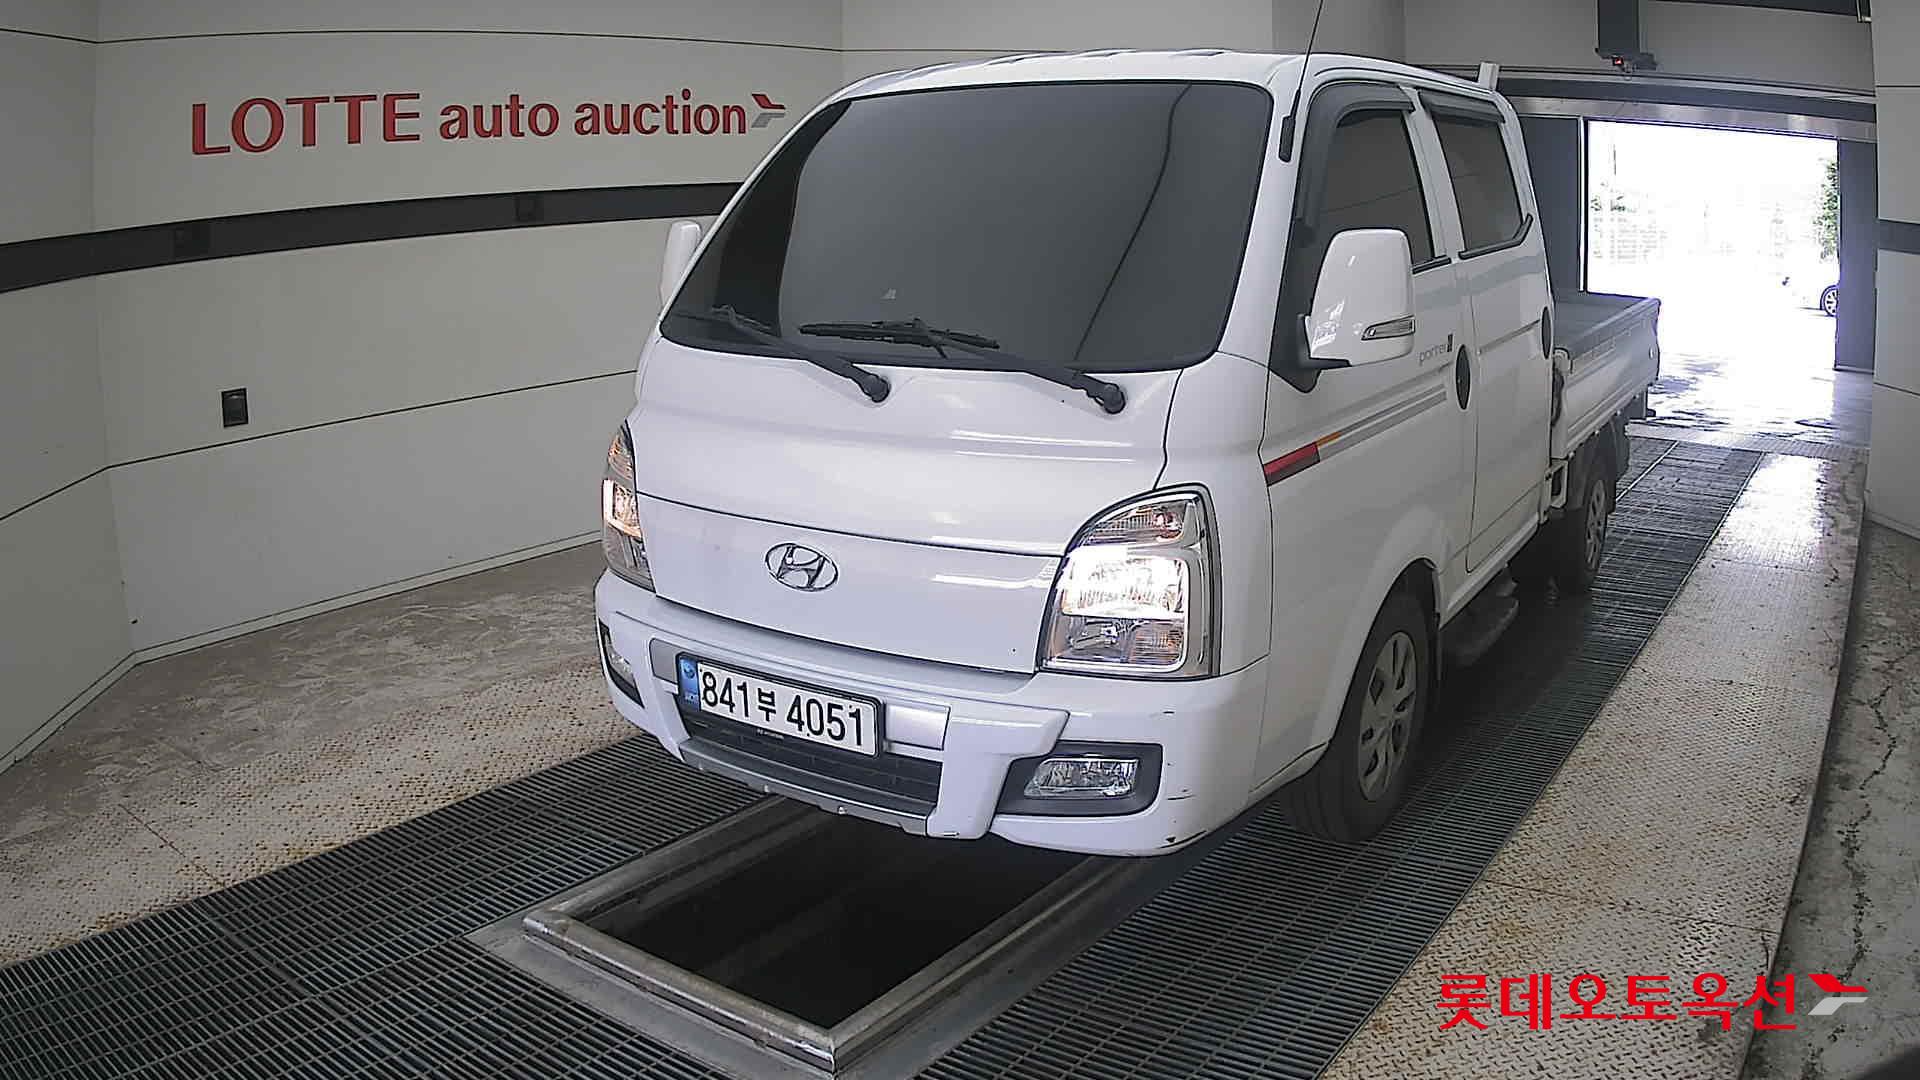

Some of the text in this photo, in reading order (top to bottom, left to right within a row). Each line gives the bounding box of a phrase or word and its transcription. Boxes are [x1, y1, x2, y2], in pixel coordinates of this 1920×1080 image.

[191, 89, 747, 156] LOTTE auto auction
[786, 694, 863, 746] 4051
